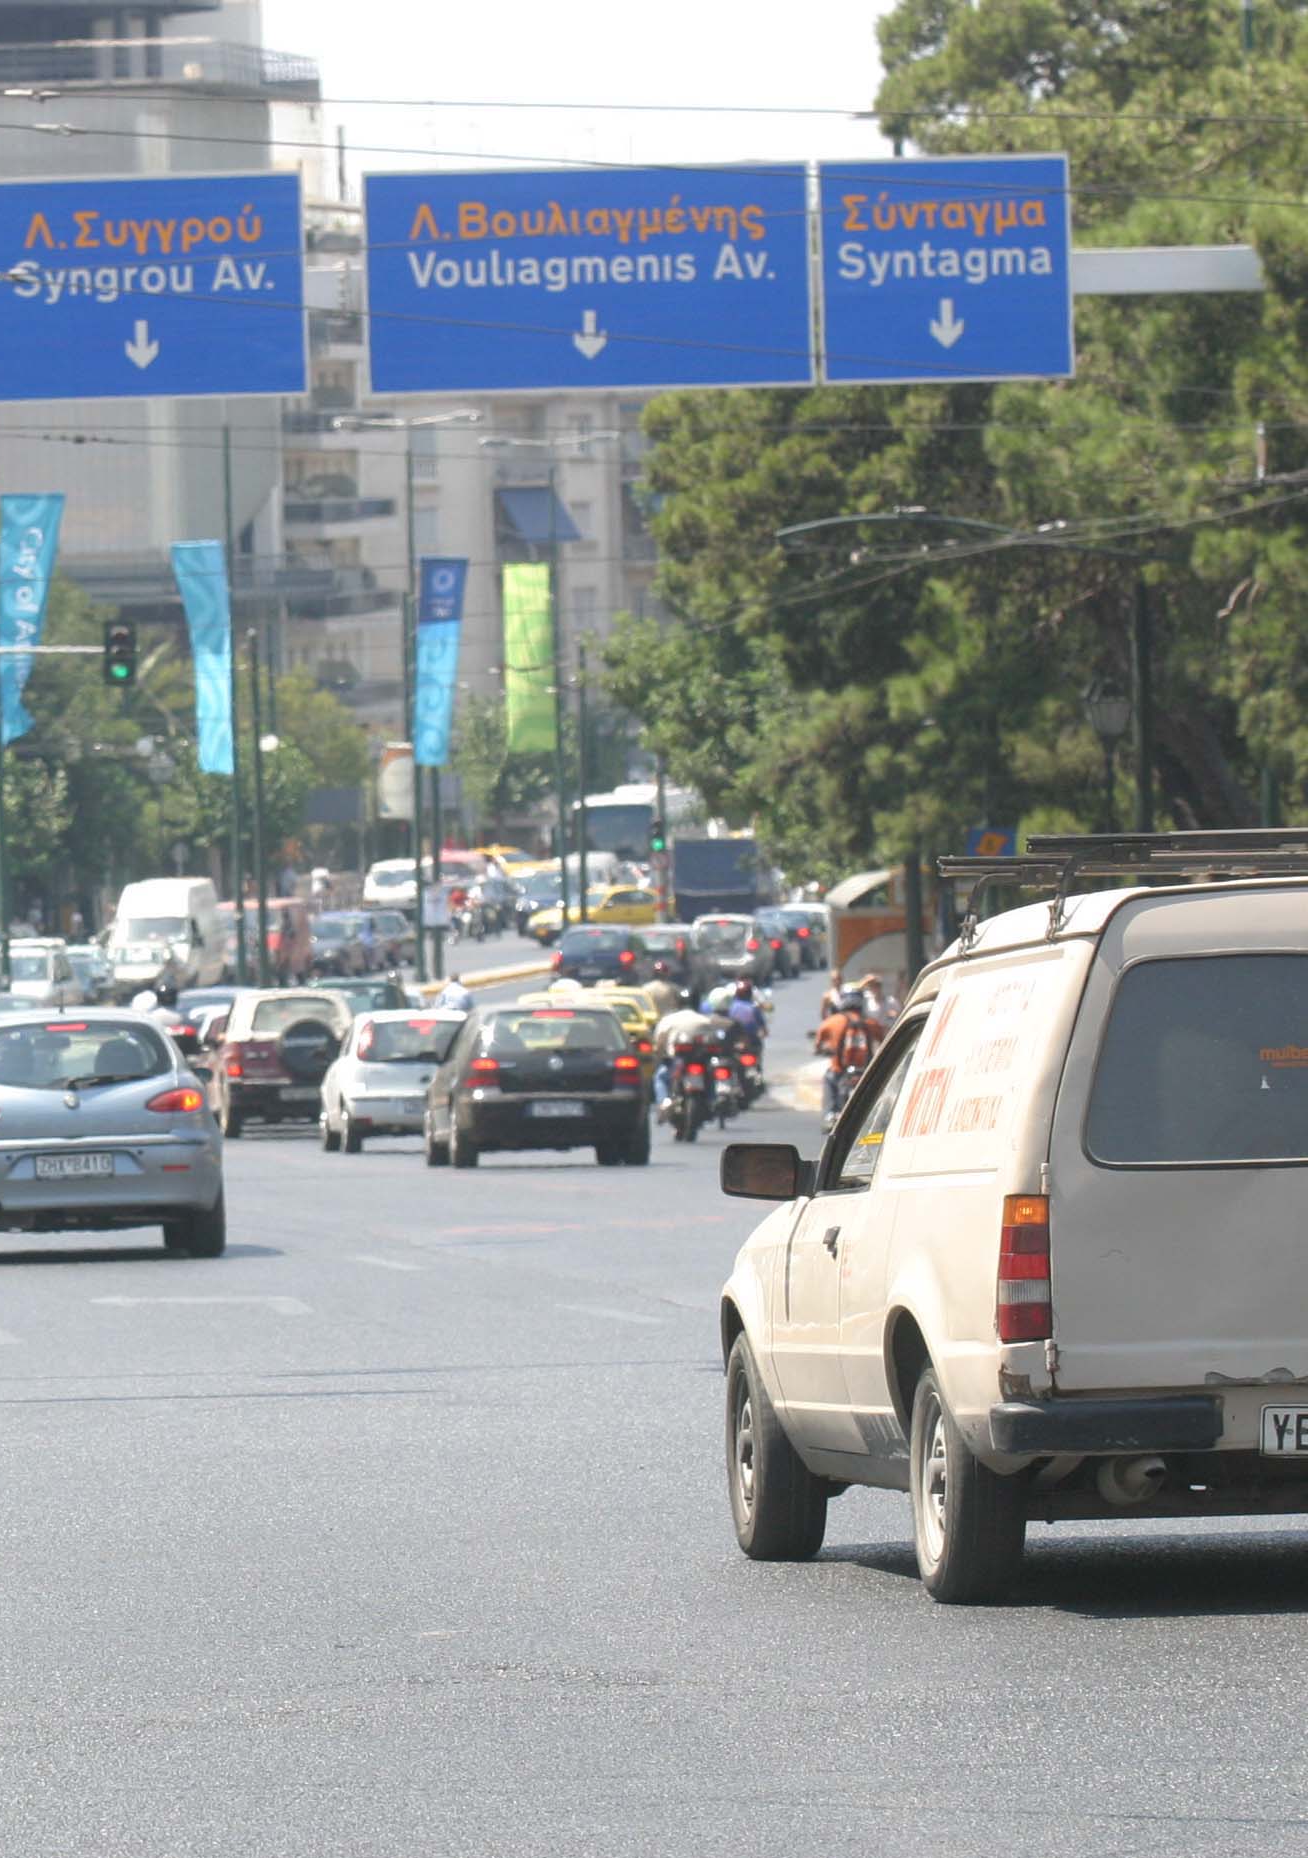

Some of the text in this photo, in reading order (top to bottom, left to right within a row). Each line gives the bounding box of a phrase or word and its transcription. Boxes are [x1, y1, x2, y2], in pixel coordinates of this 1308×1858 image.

[842, 192, 1046, 238] Σύνταγμα
[13, 256, 275, 304] Syngrou Av.
[408, 244, 776, 291] Vouliagmenis Av.
[839, 243, 1052, 286] Syntagma
